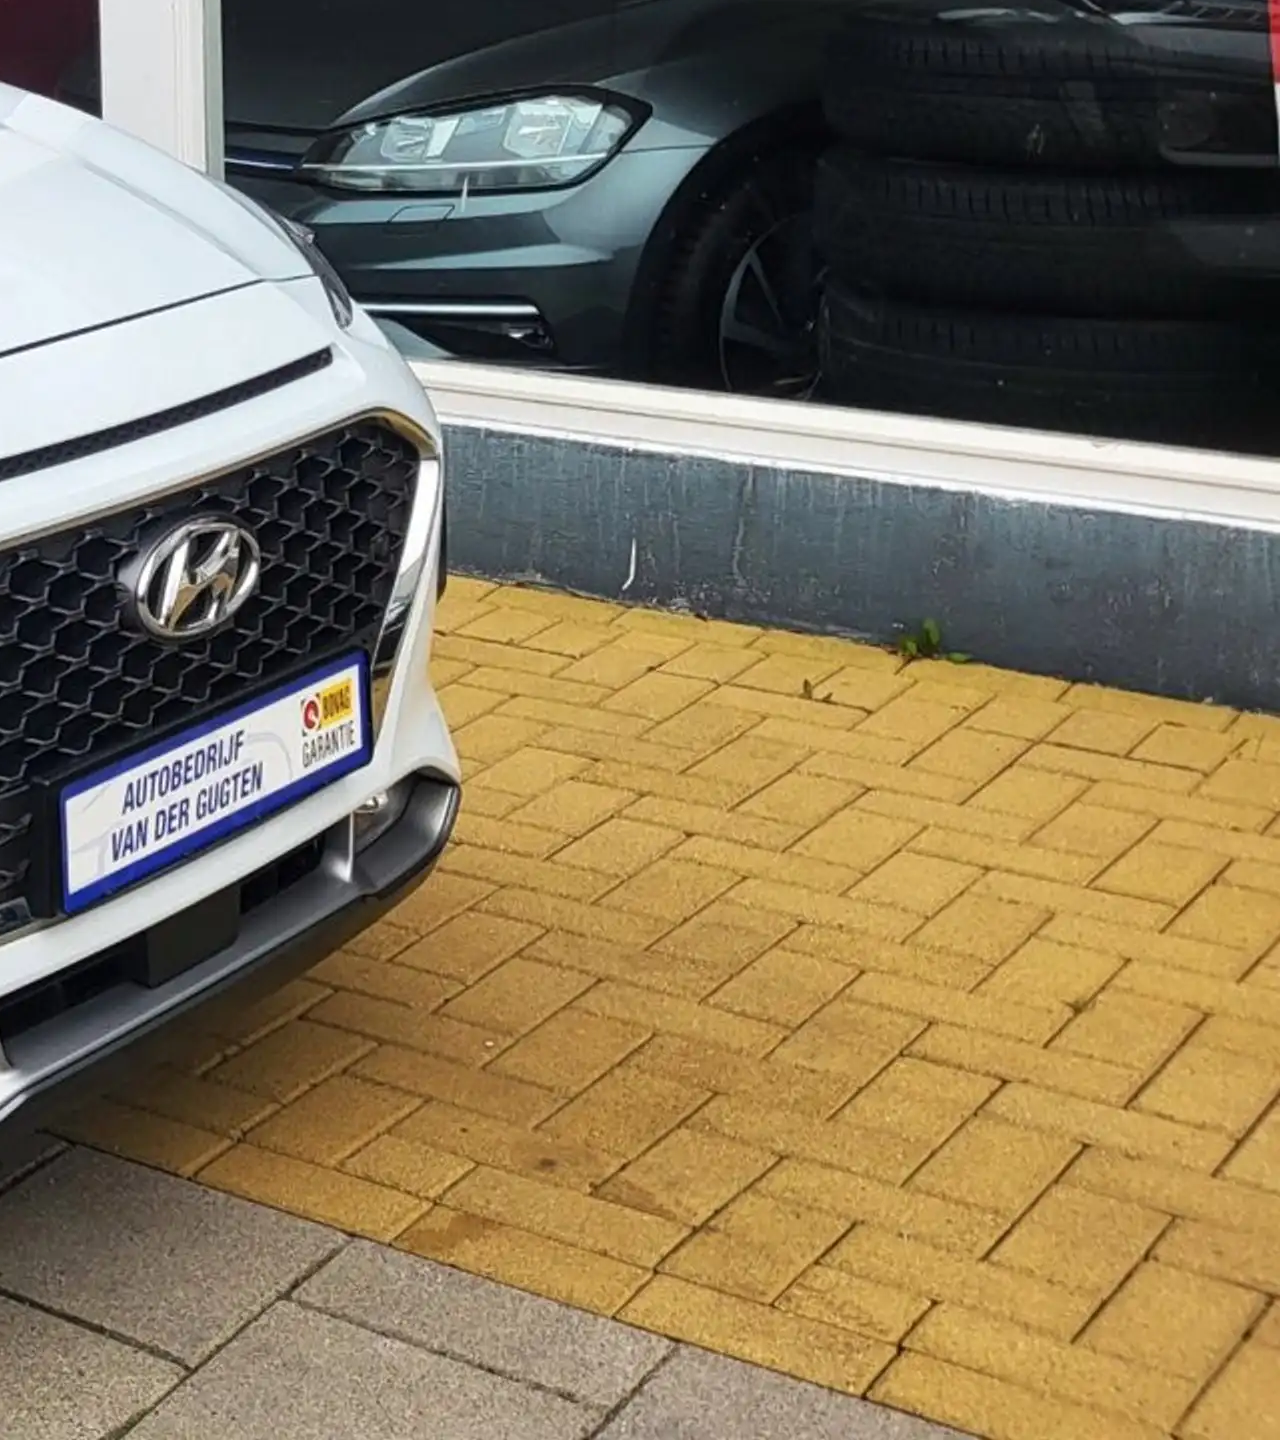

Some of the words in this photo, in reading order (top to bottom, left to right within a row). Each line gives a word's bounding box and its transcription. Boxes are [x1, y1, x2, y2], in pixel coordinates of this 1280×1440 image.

[322, 681, 352, 721] BOVAG
[122, 730, 245, 814] AUTOBEDRIJF
[301, 720, 356, 769] GARANTIE
[111, 820, 148, 862] VAN
[154, 798, 190, 842] DER
[196, 761, 264, 821] GUGTEN
